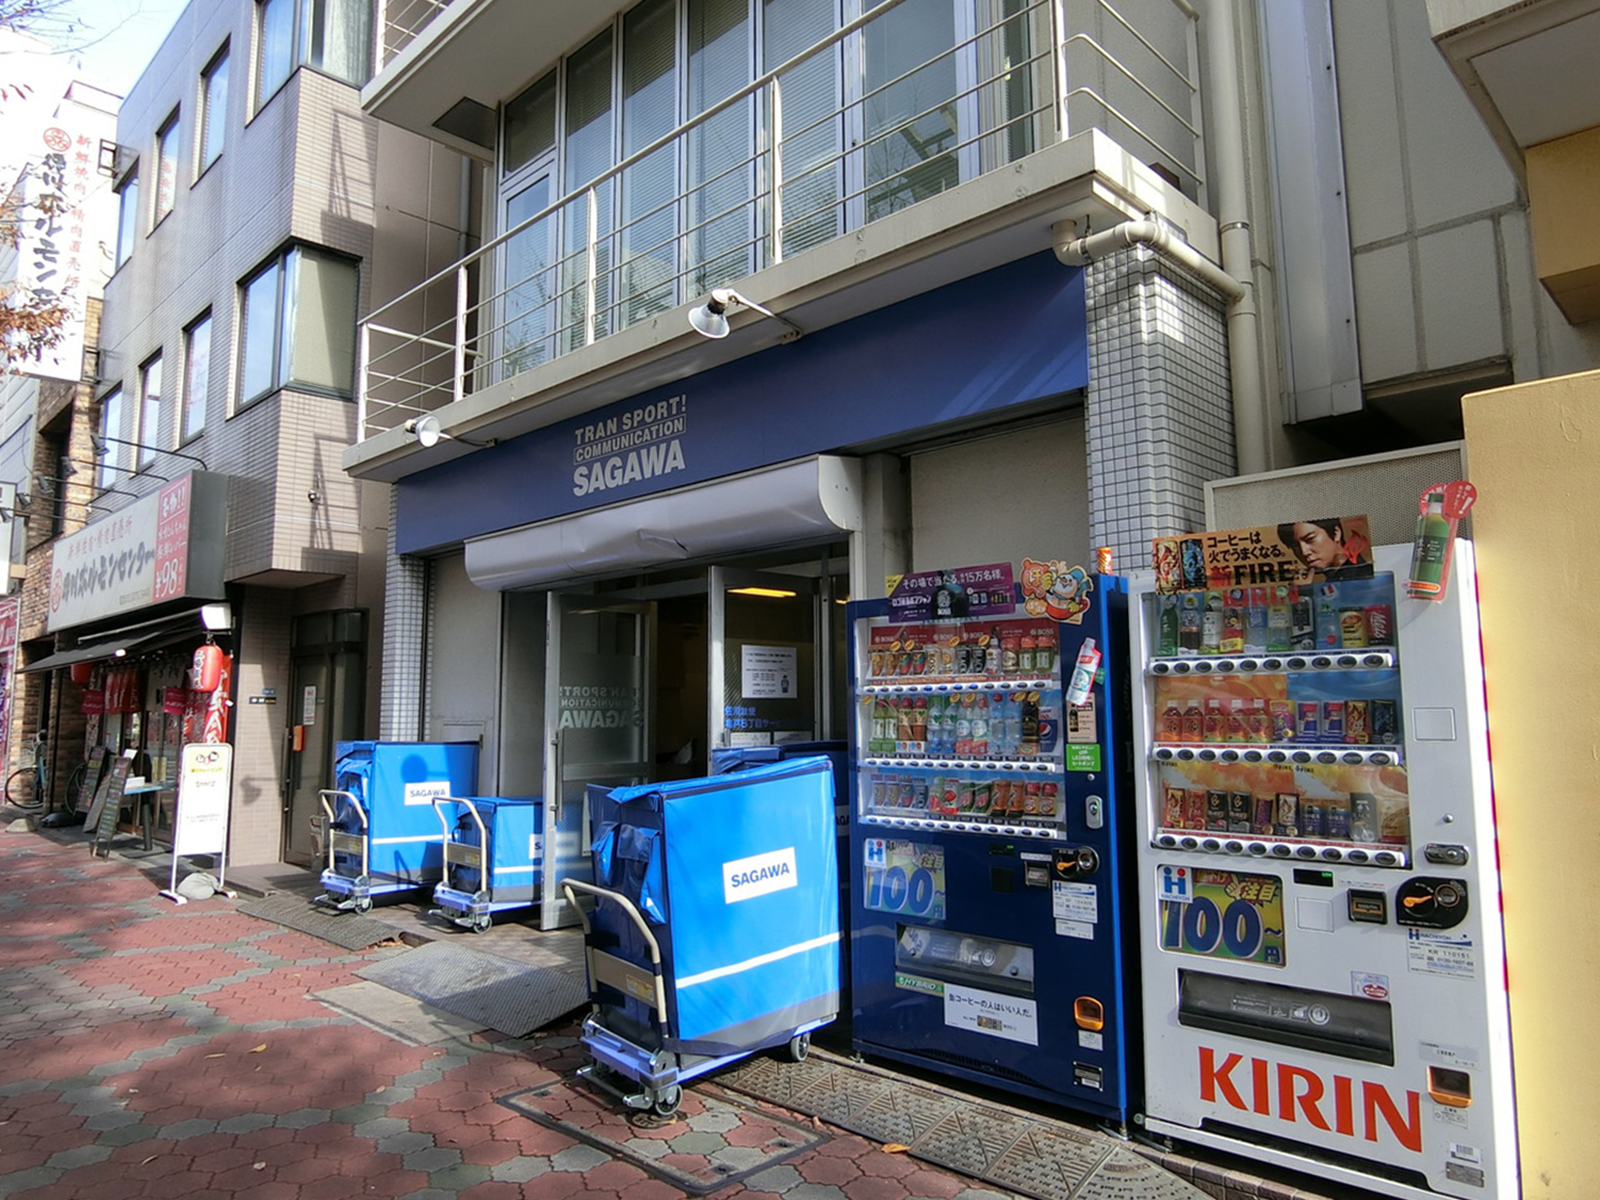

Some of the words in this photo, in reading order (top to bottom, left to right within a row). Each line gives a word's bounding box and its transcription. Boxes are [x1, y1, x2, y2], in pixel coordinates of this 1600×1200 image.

[576, 418, 683, 462] COMMUNICATION
[573, 439, 686, 497] SAGAWA
[1207, 531, 1261, 549] コーヒーは
[1208, 545, 1286, 564] 火でうまくなる。
[1234, 559, 1296, 587] FIRE
[1037, 627, 1055, 636] BOSS
[410, 789, 446, 798] SAGAWA
[730, 862, 791, 889] SAGAWA
[869, 865, 935, 916] 100
[1241, 881, 1277, 902] 注目
[1163, 896, 1264, 958] 100
[1198, 1045, 1423, 1153] KIRIN
